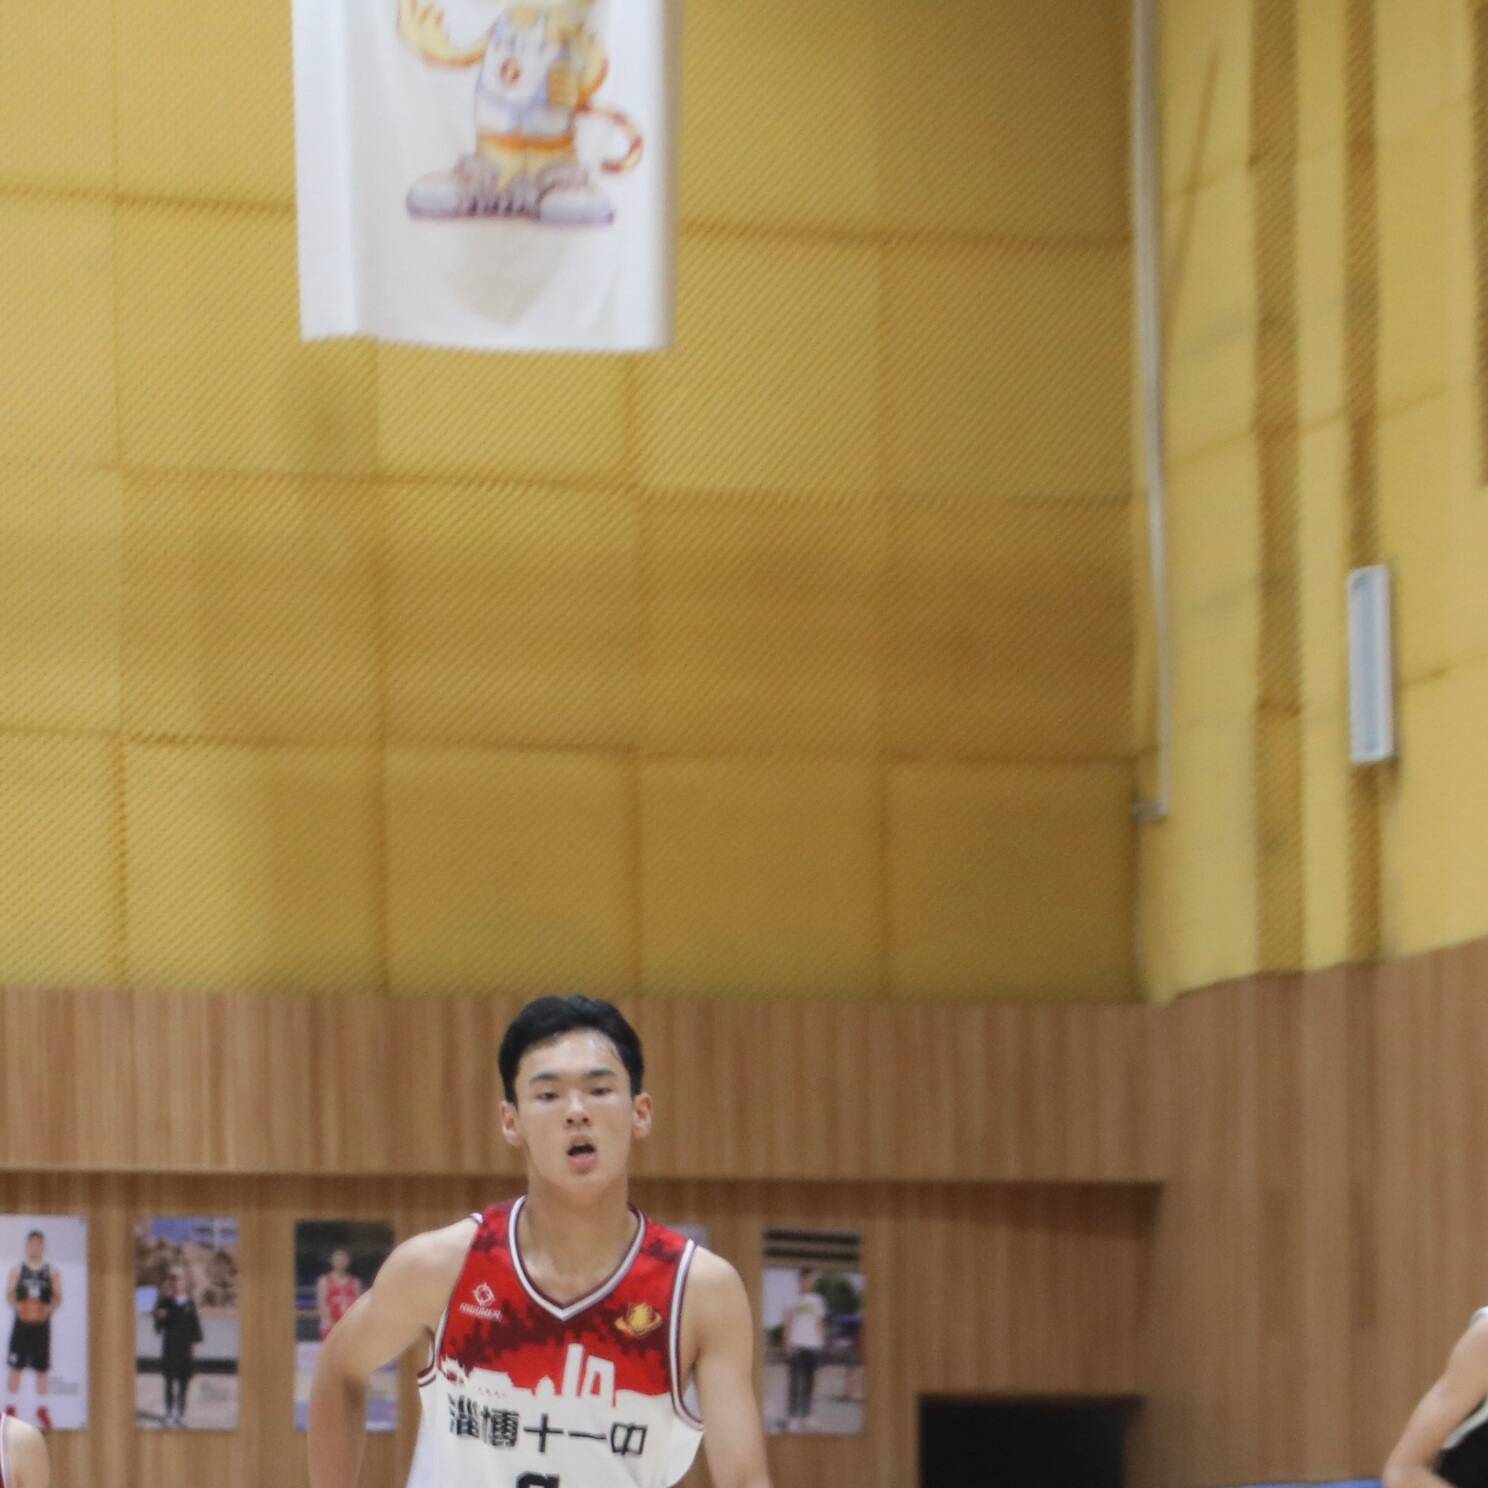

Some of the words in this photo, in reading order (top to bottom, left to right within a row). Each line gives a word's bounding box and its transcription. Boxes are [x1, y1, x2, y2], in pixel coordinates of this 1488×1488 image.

[447, 1393, 648, 1456] 淄博十一中
